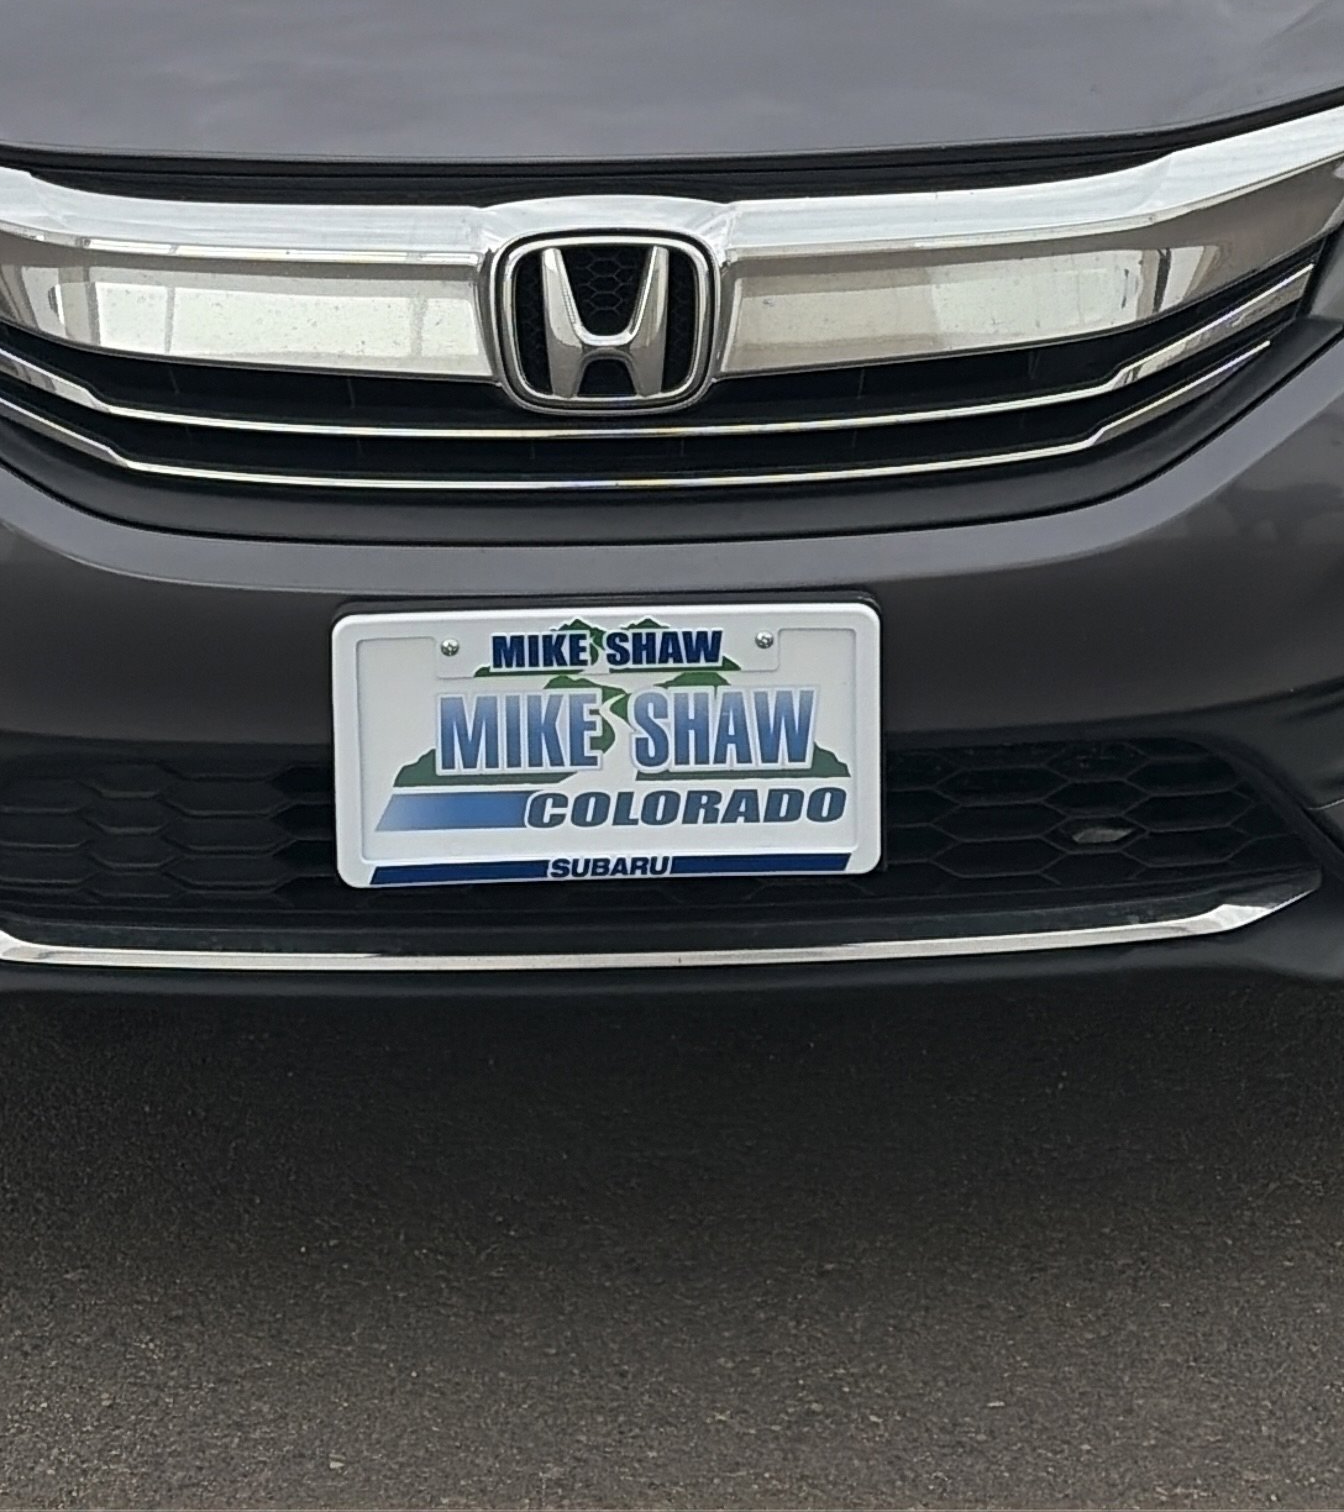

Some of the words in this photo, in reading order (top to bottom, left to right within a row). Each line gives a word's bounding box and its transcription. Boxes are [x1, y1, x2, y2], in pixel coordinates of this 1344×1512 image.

[491, 632, 588, 669] MIKE
[605, 630, 723, 667] SHAW
[439, 693, 600, 771] MIKE
[632, 688, 815, 767] SHAW
[525, 787, 848, 829] COLORADO
[549, 856, 670, 879] SUBARU
